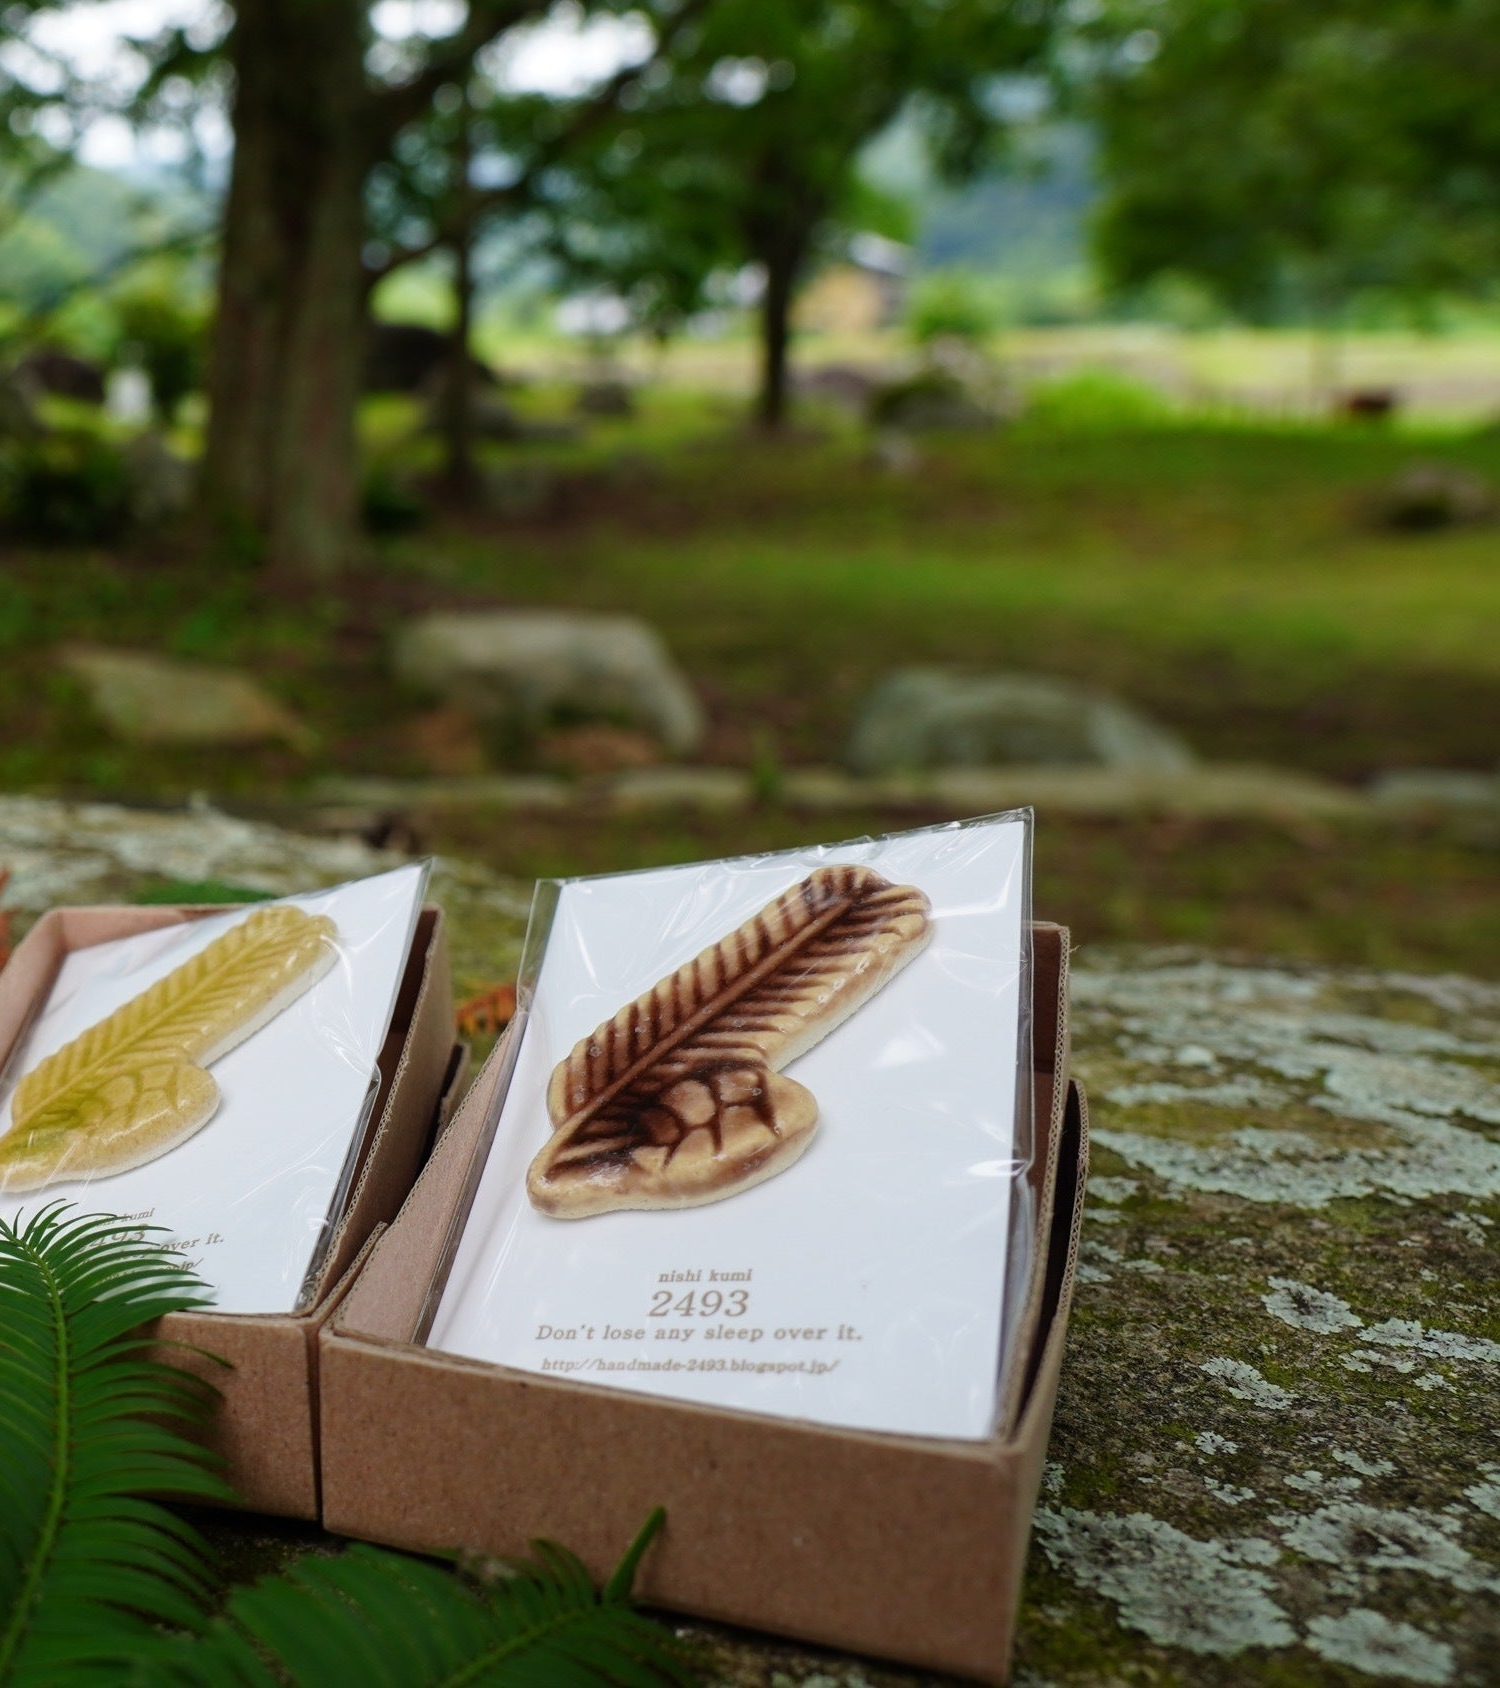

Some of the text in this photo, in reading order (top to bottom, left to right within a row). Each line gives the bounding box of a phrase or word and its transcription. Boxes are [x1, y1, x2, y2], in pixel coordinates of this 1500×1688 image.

[159, 1232, 225, 1252] over it.
[658, 1268, 753, 1283] nishi kumi
[647, 1289, 750, 1318] 2493
[535, 1323, 863, 1343] Don't lose any sleep over it.
[540, 1356, 841, 1375] http://handmade-2493.blogspot.jp/
